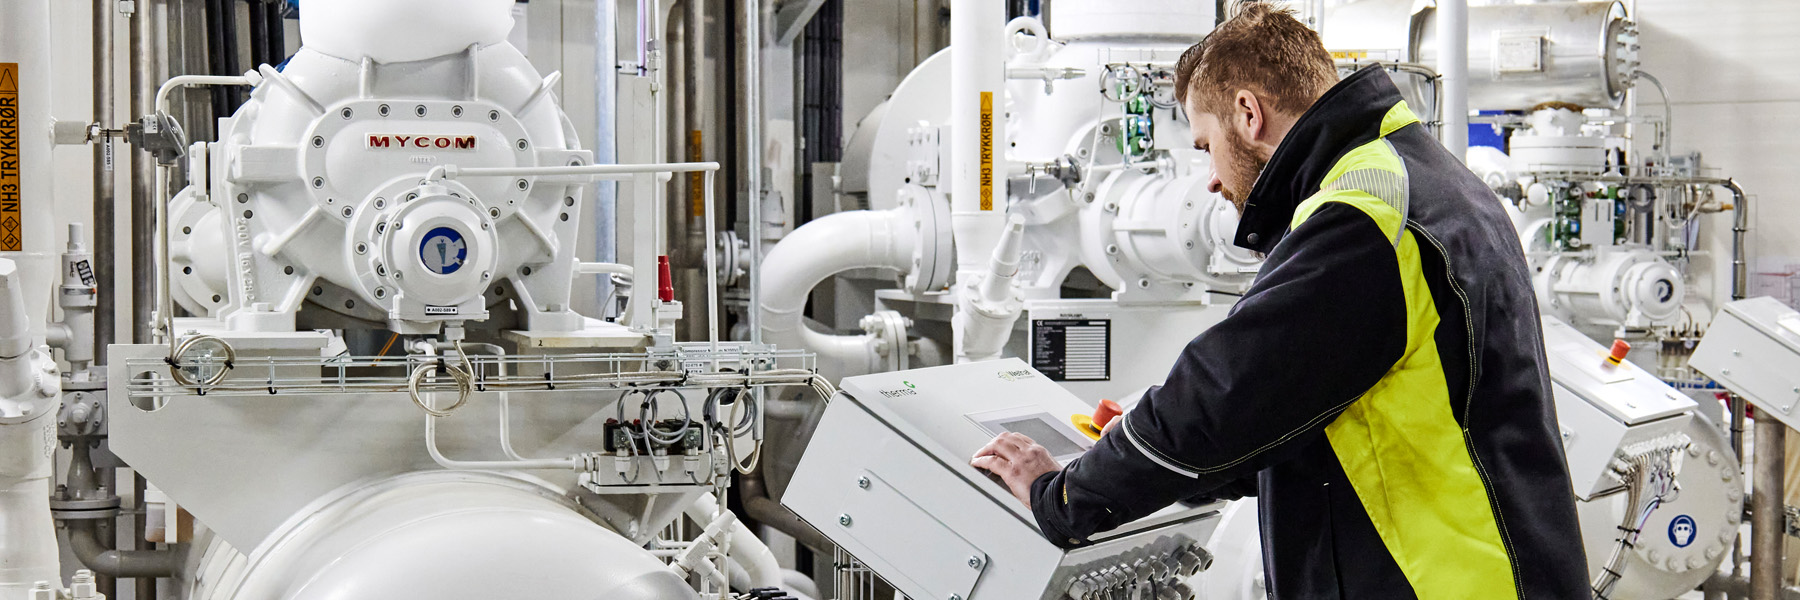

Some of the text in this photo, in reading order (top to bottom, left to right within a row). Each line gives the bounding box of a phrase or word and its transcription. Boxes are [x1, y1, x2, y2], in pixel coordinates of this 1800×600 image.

[0, 97, 18, 212] NH3 TRYKKRØR
[369, 135, 476, 149] MYCOM
[981, 114, 991, 186] NH3 TRYKKRØR
[879, 389, 917, 399] therma
